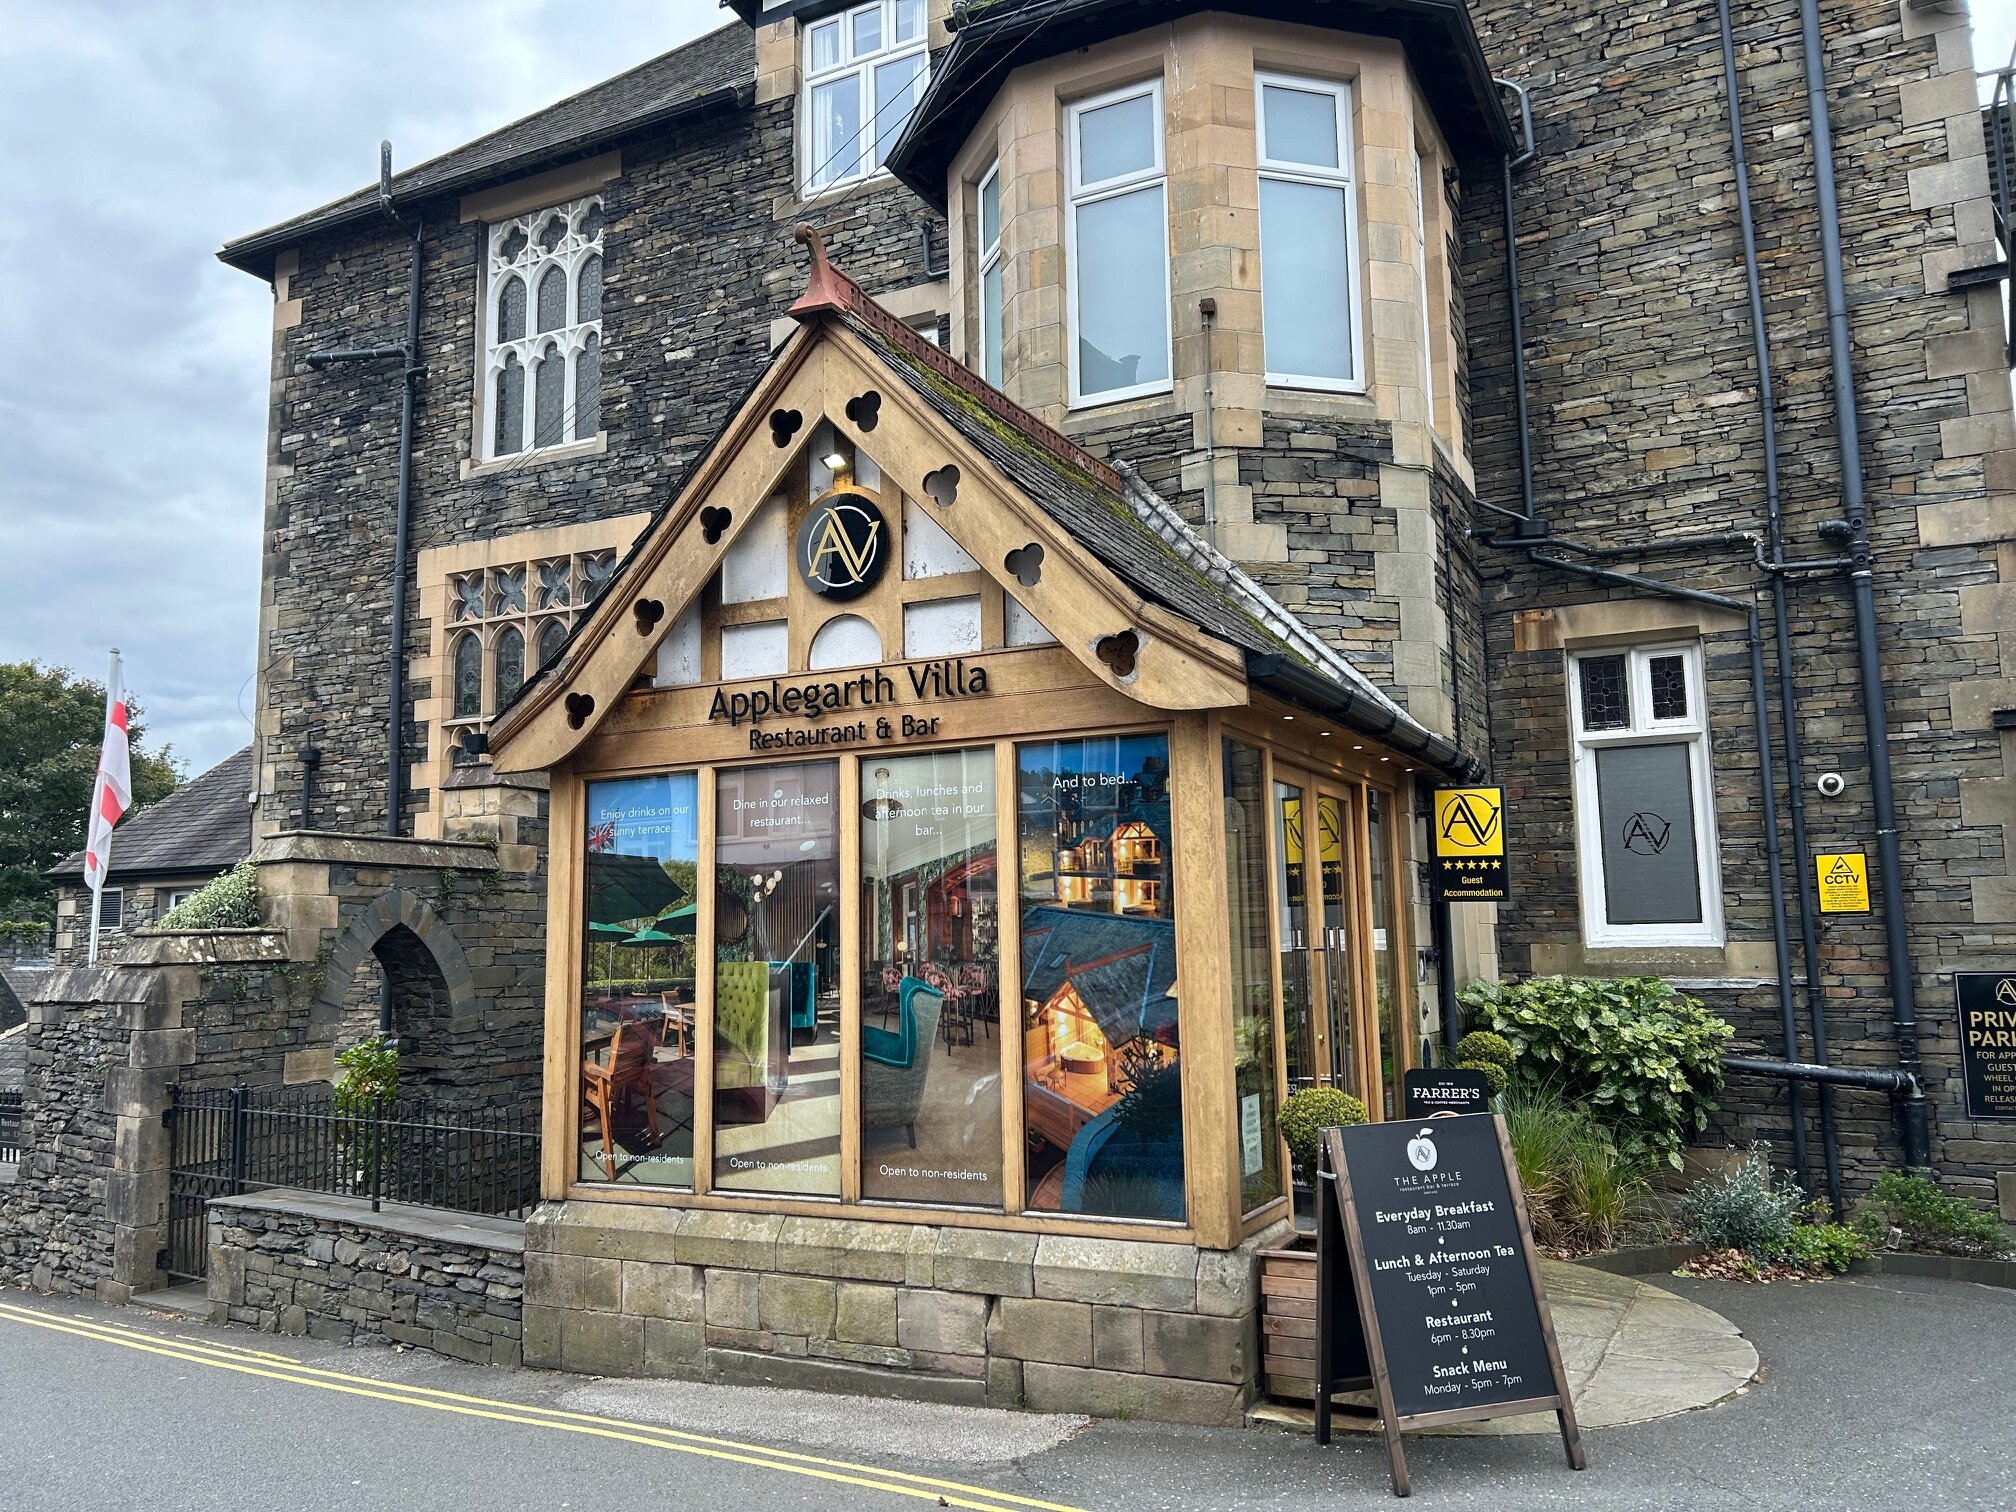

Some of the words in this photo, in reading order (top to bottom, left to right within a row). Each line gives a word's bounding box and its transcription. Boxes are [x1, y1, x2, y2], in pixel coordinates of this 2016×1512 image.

[708, 668, 895, 727] Applegarth
[906, 659, 990, 700] Villa
[749, 720, 866, 750] Restaurant
[876, 717, 892, 739] &
[901, 714, 939, 737] Bar
[1052, 776, 1079, 789] And
[1082, 776, 1096, 787] to
[1099, 773, 1137, 786] bed...
[877, 788, 913, 800] Drinks,
[916, 784, 958, 797] lunches
[962, 781, 983, 793] and
[733, 799, 756, 811] Dine
[758, 798, 768, 808] in
[771, 798, 787, 808] our
[790, 795, 829, 807] relaxed
[600, 809, 625, 821] Enjoy
[628, 807, 656, 818] drinks
[658, 808, 671, 816] on
[673, 806, 689, 815] our
[875, 807, 928, 820] afternoon
[931, 805, 949, 816] tea
[952, 803, 962, 815] in
[966, 803, 985, 814] our
[750, 815, 810, 828] restaurant...
[609, 826, 636, 837] sunny
[637, 823, 680, 835] terrace...
[915, 824, 943, 837] bar...
[1462, 876, 1483, 884] Guest
[1825, 875, 1859, 884] CCTV
[1444, 889, 1503, 897] Accommodation
[1976, 1051, 1996, 1060] FOR
[1984, 1074, 2013, 1082] WHEEL
[1413, 1088, 1480, 1099] FARRER'S
[595, 1151, 617, 1163] Open
[619, 1153, 628, 1161] to
[630, 1154, 684, 1164] non-residents
[730, 1158, 754, 1170] Open
[757, 1160, 766, 1169] to
[768, 1161, 828, 1172] non-residents
[880, 1165, 906, 1177] Open
[909, 1167, 919, 1176] to
[921, 1168, 988, 1181] non-residents
[1394, 1176, 1418, 1186] THE
[1424, 1172, 1462, 1183] APPLE
[1376, 1207, 1431, 1223] Everyday
[1435, 1201, 1494, 1217] Breakfast
[1407, 1225, 1427, 1235] 8am
[1437, 1220, 1470, 1231] 11.30am
[1374, 1255, 1410, 1271] Lunch
[1415, 1254, 1425, 1266] &
[1429, 1248, 1491, 1264] Afternoon
[1494, 1245, 1515, 1257] Tea
[1406, 1270, 1441, 1282] Tuesday
[1451, 1264, 1490, 1277] Saturday
[1427, 1285, 1446, 1298] 1pm
[1456, 1281, 1476, 1294] 5pm
[1426, 1310, 1493, 1328] Restaurant
[1431, 1333, 1451, 1346] 6pm
[1462, 1328, 1495, 1340] 8.30pm
[1433, 1361, 1470, 1378] Snack
[1473, 1360, 1507, 1373] Menu
[1424, 1382, 1461, 1395] Monday
[1471, 1379, 1492, 1391] 5pm
[1502, 1375, 1522, 1388] 7pm
